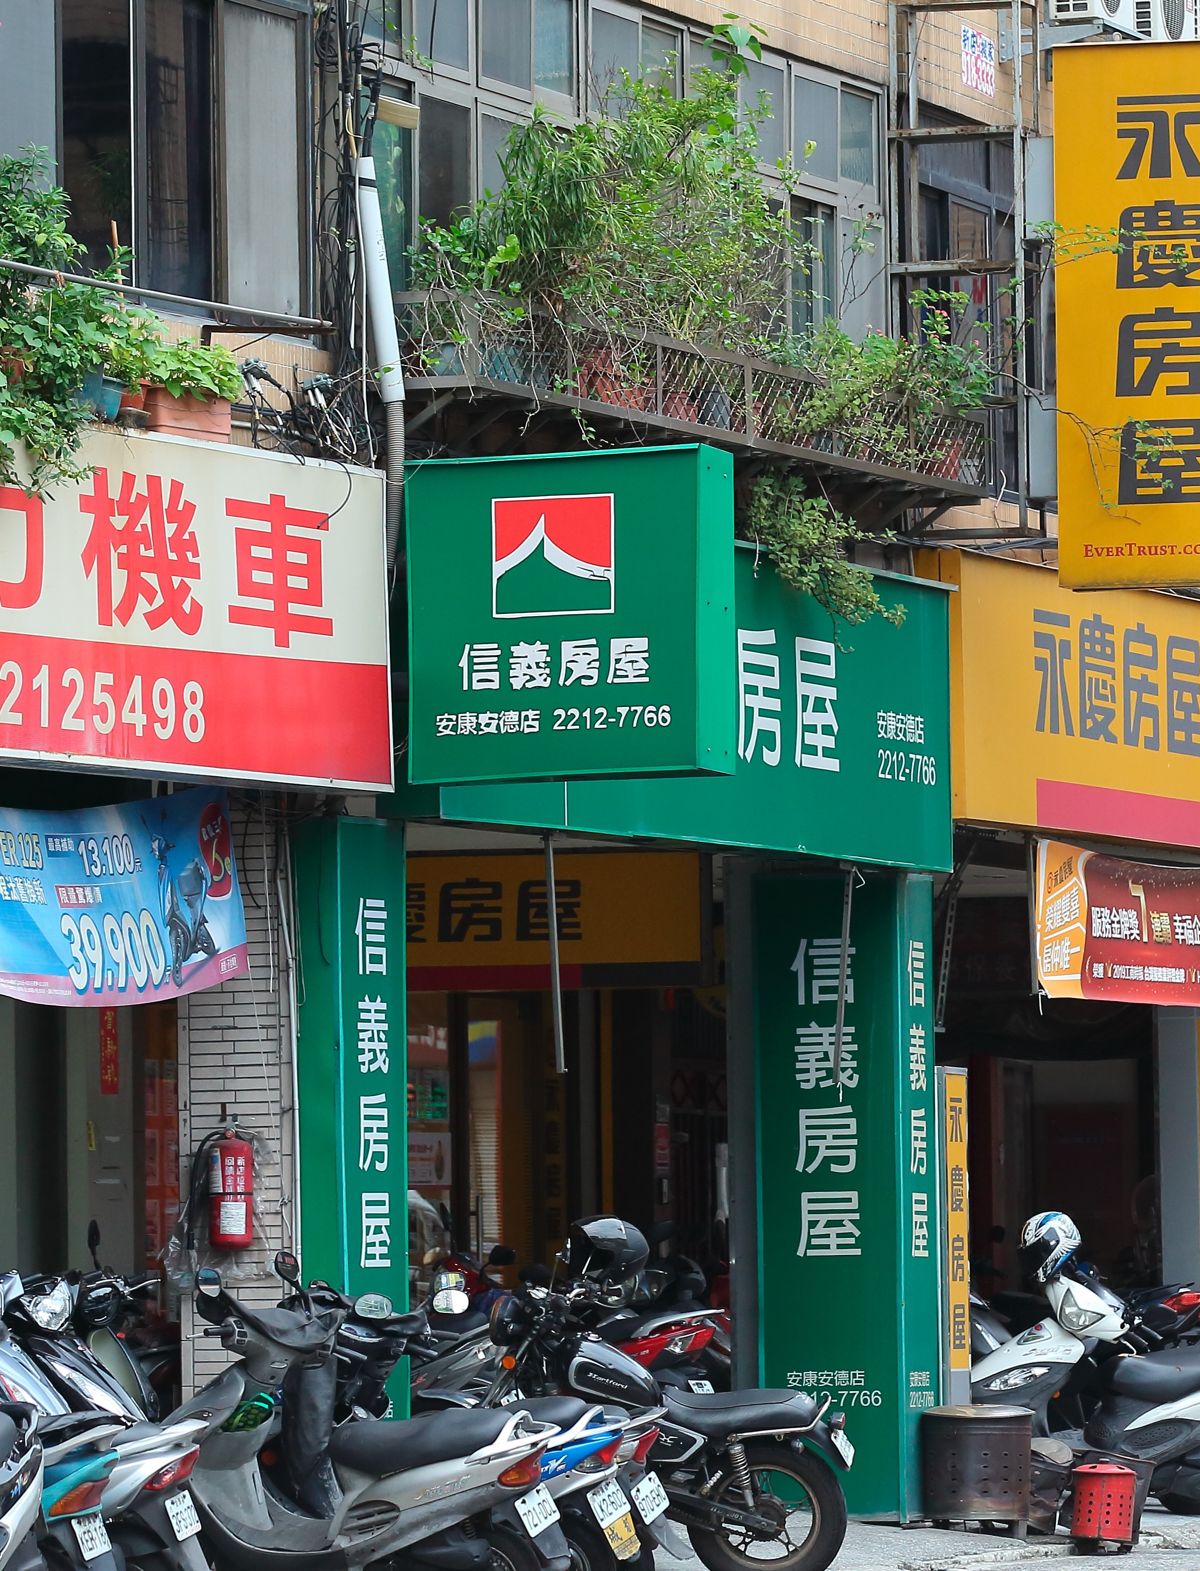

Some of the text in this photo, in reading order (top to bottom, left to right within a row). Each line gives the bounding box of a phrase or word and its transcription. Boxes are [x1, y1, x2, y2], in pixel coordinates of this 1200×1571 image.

[458, 636, 650, 690] 信義房屋
[436, 704, 671, 736] 安康安德店 2212-7766
[736, 627, 840, 773] 房屋
[877, 709, 924, 744] 安康安德店
[878, 748, 936, 786] 2212-7766
[1043, 938, 1081, 972] 房仲唯一
[355, 898, 391, 1269] 信義房屋
[792, 938, 862, 1258] 信義房屋
[908, 940, 929, 1258] 信義房屋
[949, 1097, 967, 1350] 永慶房屋
[786, 1370, 866, 1387] 安康安德店
[909, 1391, 934, 1408] 2212-7766
